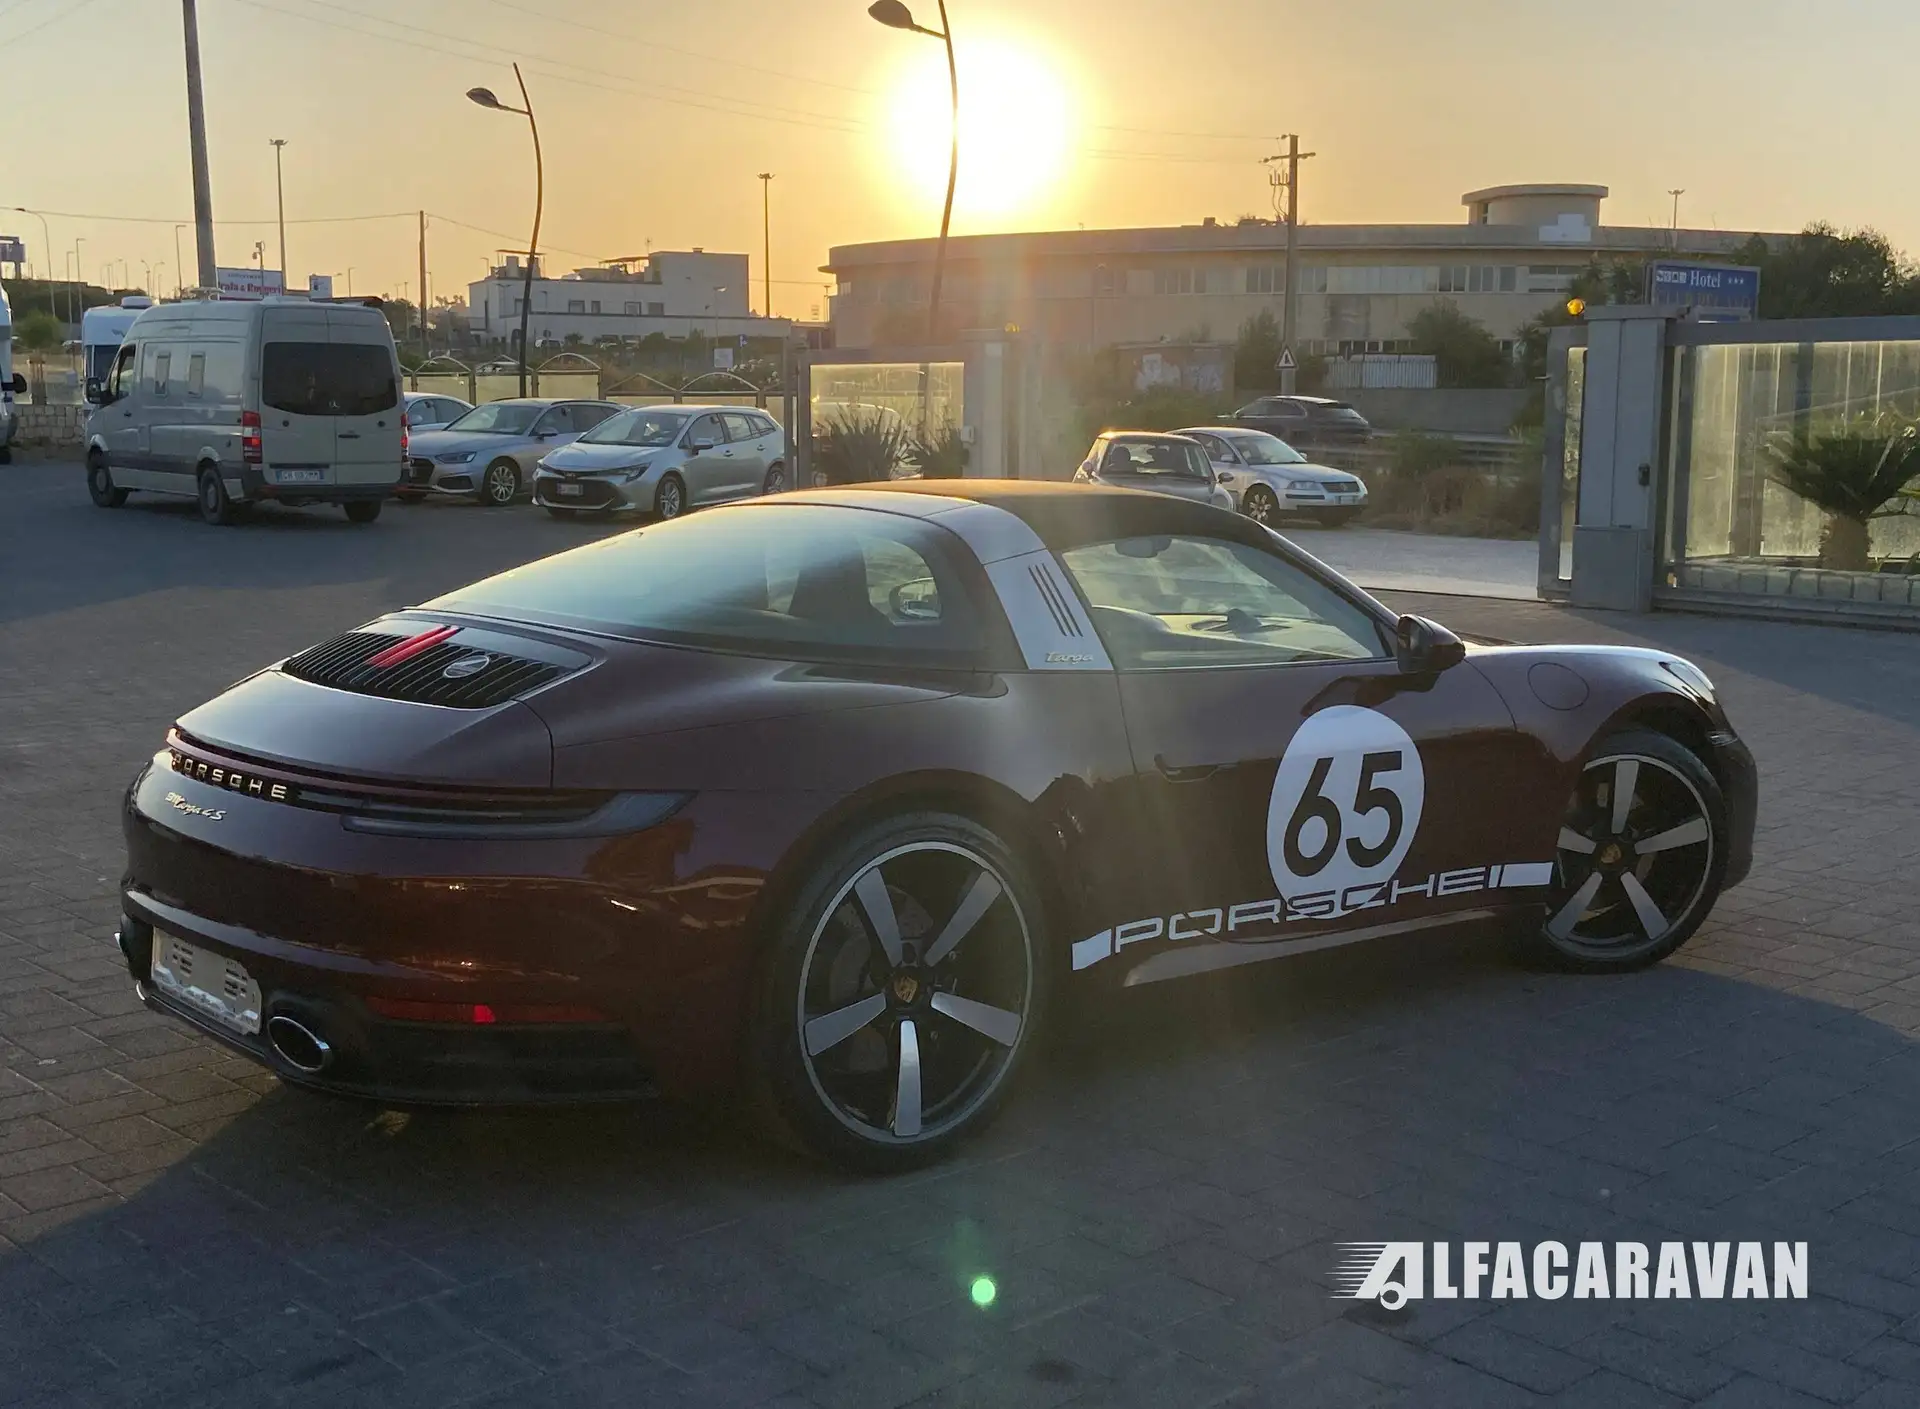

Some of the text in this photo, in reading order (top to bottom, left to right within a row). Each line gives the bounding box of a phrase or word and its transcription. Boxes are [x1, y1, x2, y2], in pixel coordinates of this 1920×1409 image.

[1690, 269, 1721, 288] Hotel
[1045, 651, 1094, 664] Targa
[172, 753, 287, 799] PORSCHE
[1283, 750, 1404, 878] 65
[1114, 865, 1487, 954] PORSCHE
